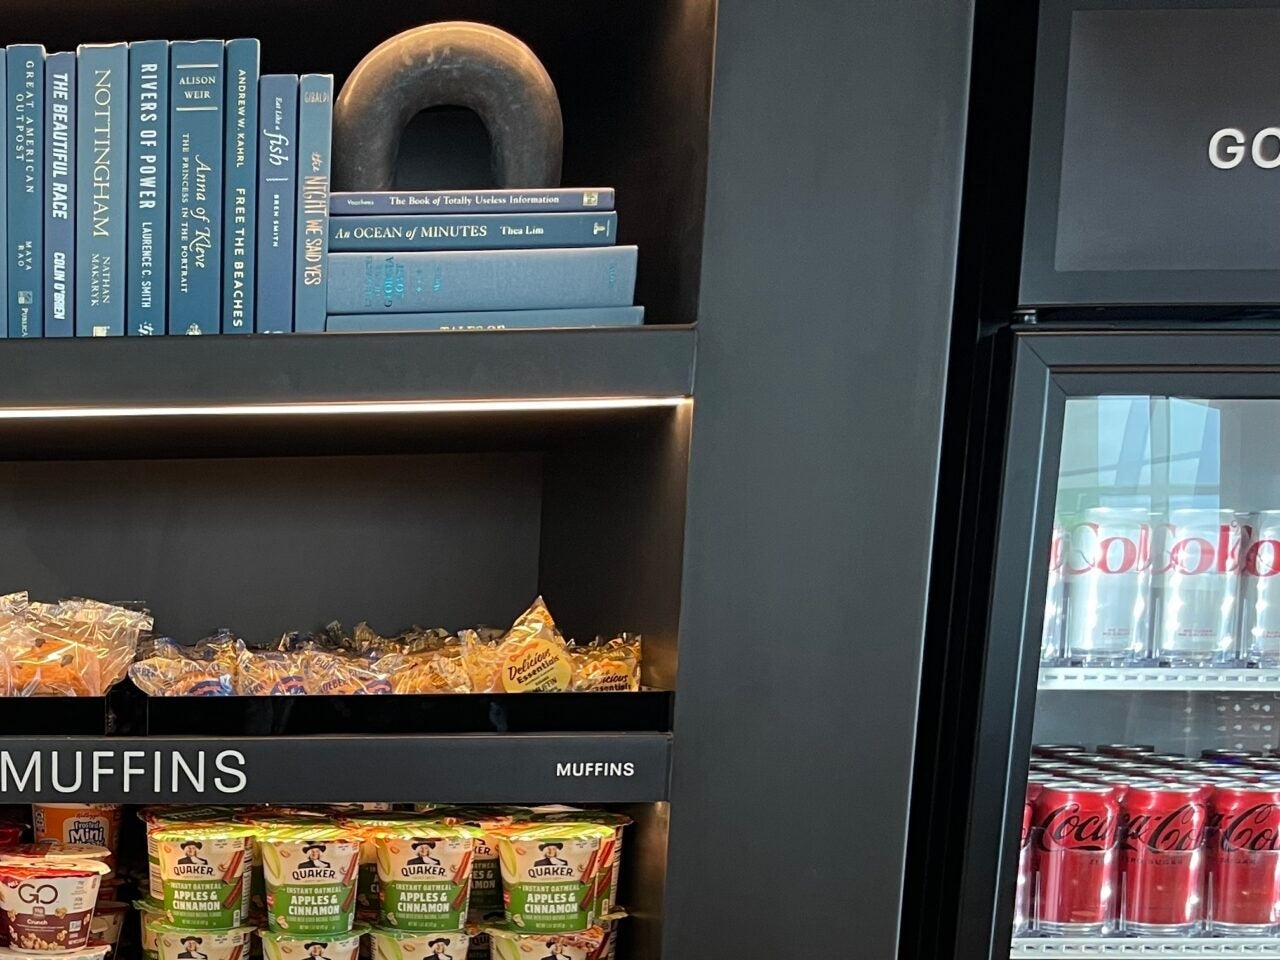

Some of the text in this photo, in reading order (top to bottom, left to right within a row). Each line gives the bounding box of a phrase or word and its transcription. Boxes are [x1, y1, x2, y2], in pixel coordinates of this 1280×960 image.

[179, 76, 216, 85] ALISON
[237, 69, 247, 117] ANDREW
[184, 90, 211, 99] WEIR
[15, 93, 25, 161] OUTPOST
[25, 60, 35, 194] GREAT AMERICAN
[138, 63, 158, 209] RIVERS OF POWER
[51, 72, 69, 220] THE BEAUTIFUL RACE
[93, 69, 112, 237] NOTTINGHAM
[236, 133, 245, 169] KAHRL
[263, 128, 290, 167] fish
[303, 175, 329, 218] NIGHT
[389, 193, 560, 207] The Book of Totally Useless Information
[180, 132, 190, 294] THE PRINCESS IN THE PORTRAIT
[189, 154, 212, 269] Anna of Kleve
[272, 194, 280, 248] BREN SMITH
[305, 218, 324, 237] WE
[335, 225, 545, 241] An OCEAN of MINUTES Thea Lim
[17, 245, 25, 267] RAO
[25, 240, 33, 271] MAYA
[141, 222, 153, 268] LAURENCE
[305, 238, 323, 263] SAID
[53, 251, 66, 282] COLIN
[231, 188, 246, 328] FREE THE BEACHES
[90, 253, 100, 307] MAKARYK
[102, 256, 111, 304] NATHAN
[303, 264, 323, 286] YES
[140, 280, 152, 309] SMITH
[508, 648, 551, 680] Delicious
[0, 749, 248, 794] MUFFINS
[556, 762, 635, 778] MUFFINS
[173, 864, 215, 877] QUAKER
[292, 867, 336, 880] QUAKER
[401, 865, 447, 877] QUAKER
[527, 866, 574, 878] QUAKER
[18, 883, 59, 905] GO
[172, 900, 221, 911] CINNAMON
[173, 890, 209, 901] APPLES
[290, 894, 329, 905] APPLES
[399, 892, 439, 902] APPLES
[526, 893, 567, 904] APPLES
[288, 904, 340, 915] CINNAMON
[397, 902, 450, 912] CINNAMON
[524, 903, 578, 914] CINNAMON
